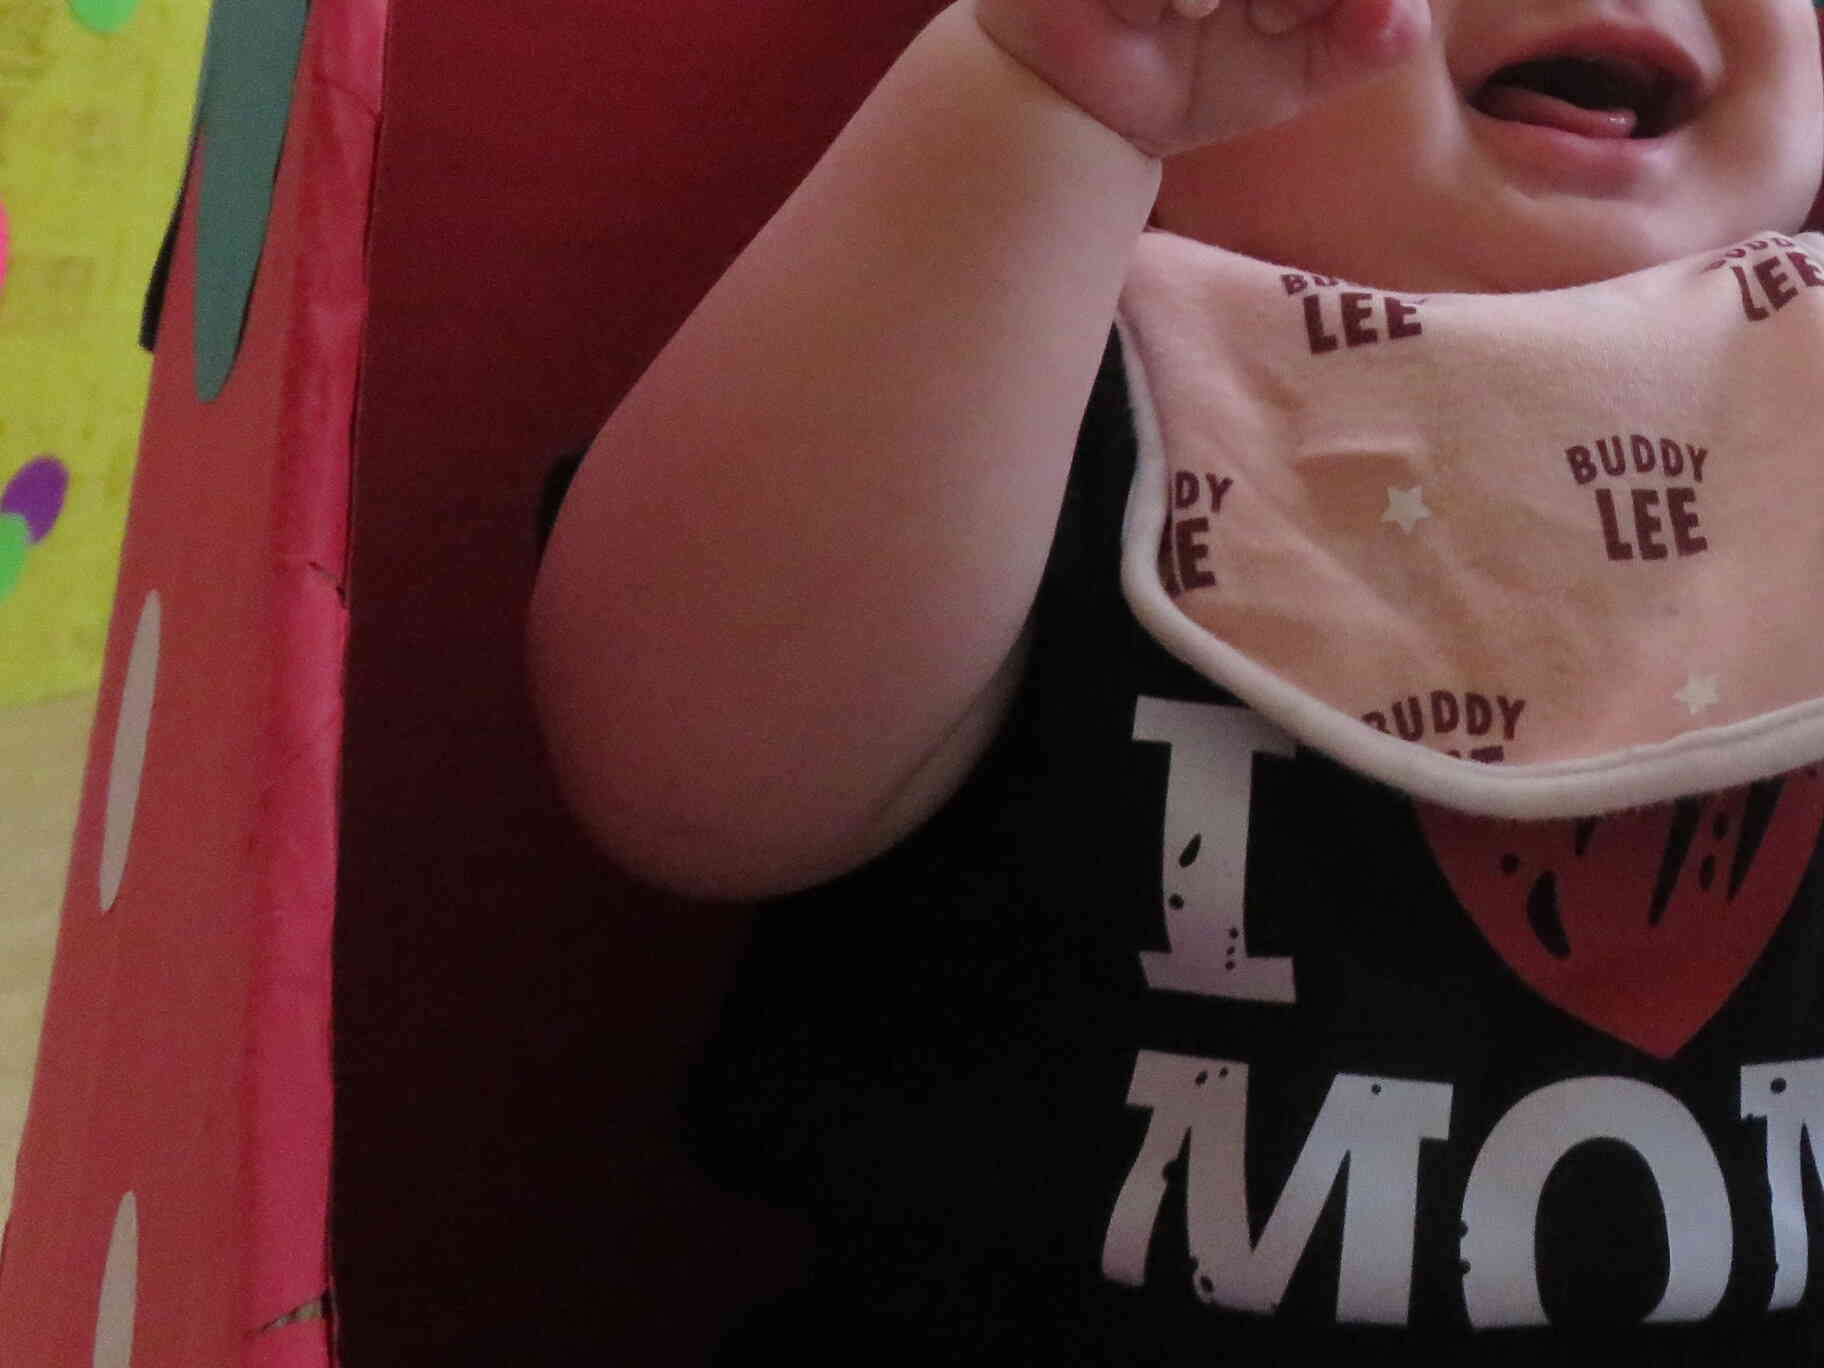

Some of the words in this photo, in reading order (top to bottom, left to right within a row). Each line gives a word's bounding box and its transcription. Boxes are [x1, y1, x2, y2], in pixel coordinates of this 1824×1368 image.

[1303, 291, 1424, 355] LEE
[1565, 434, 1709, 484] BUDDY
[1170, 470, 1234, 513] DY
[1595, 487, 1709, 561] LEE
[1132, 694, 1297, 1004] I
